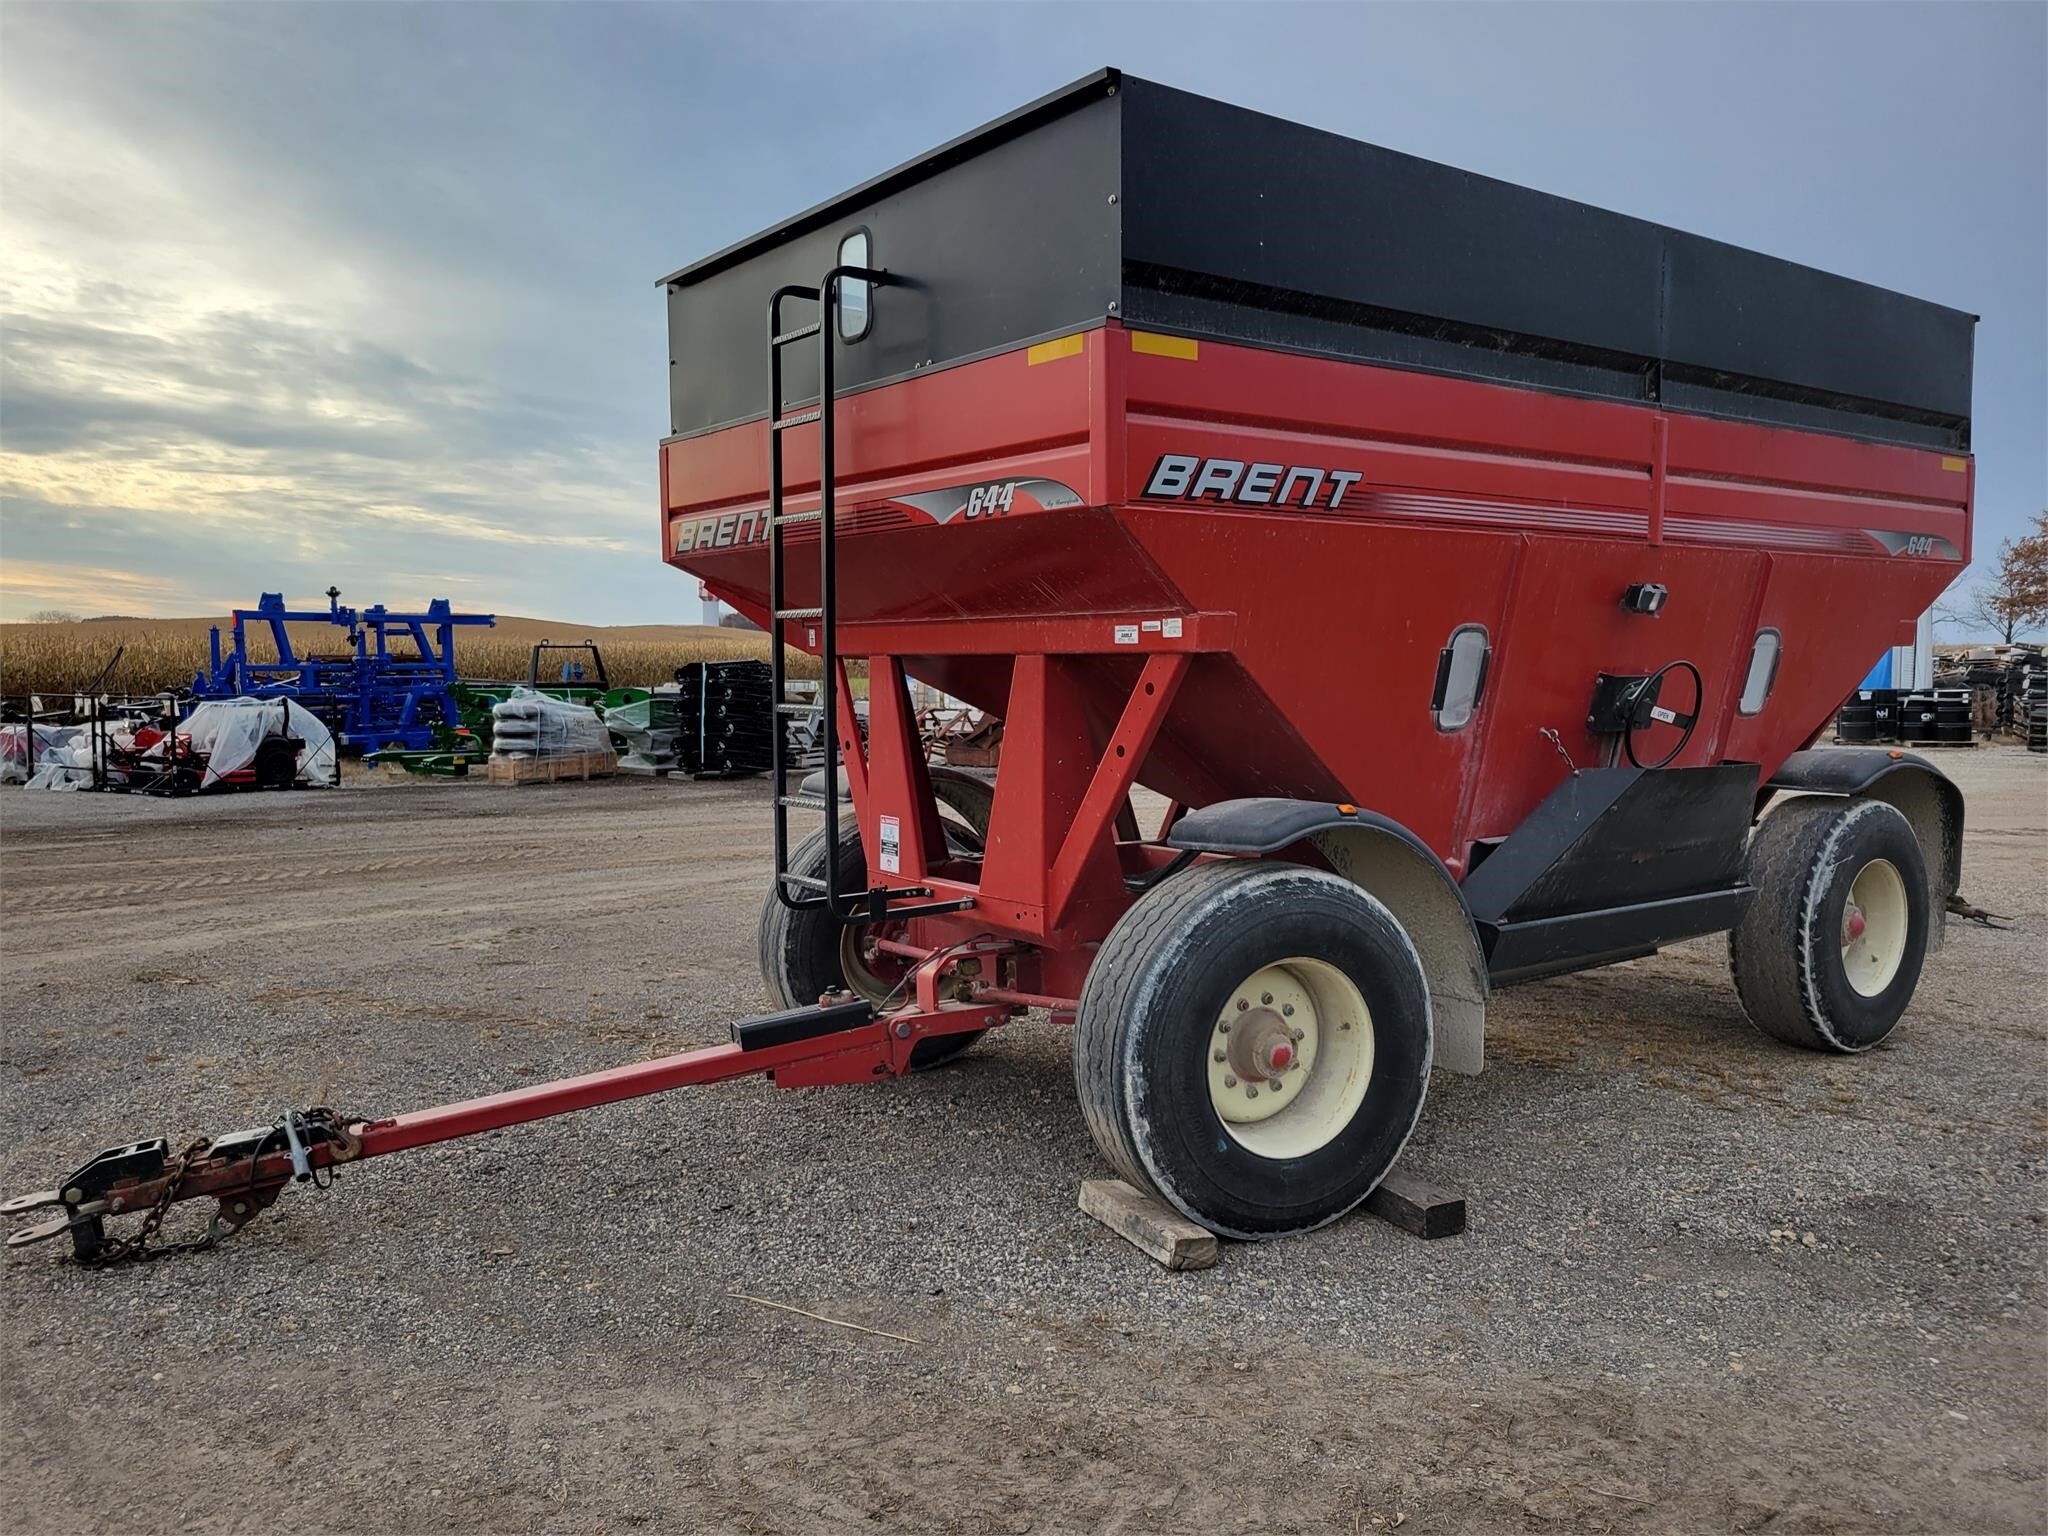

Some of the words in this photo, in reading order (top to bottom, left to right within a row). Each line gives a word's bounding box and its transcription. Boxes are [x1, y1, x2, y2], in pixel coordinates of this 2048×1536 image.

[965, 482, 1016, 519] 644
[1143, 454, 1364, 511] BRENT
[676, 509, 771, 555] BRENT
[1907, 536, 1934, 556] 644
[1657, 710, 1669, 720] OPEN
